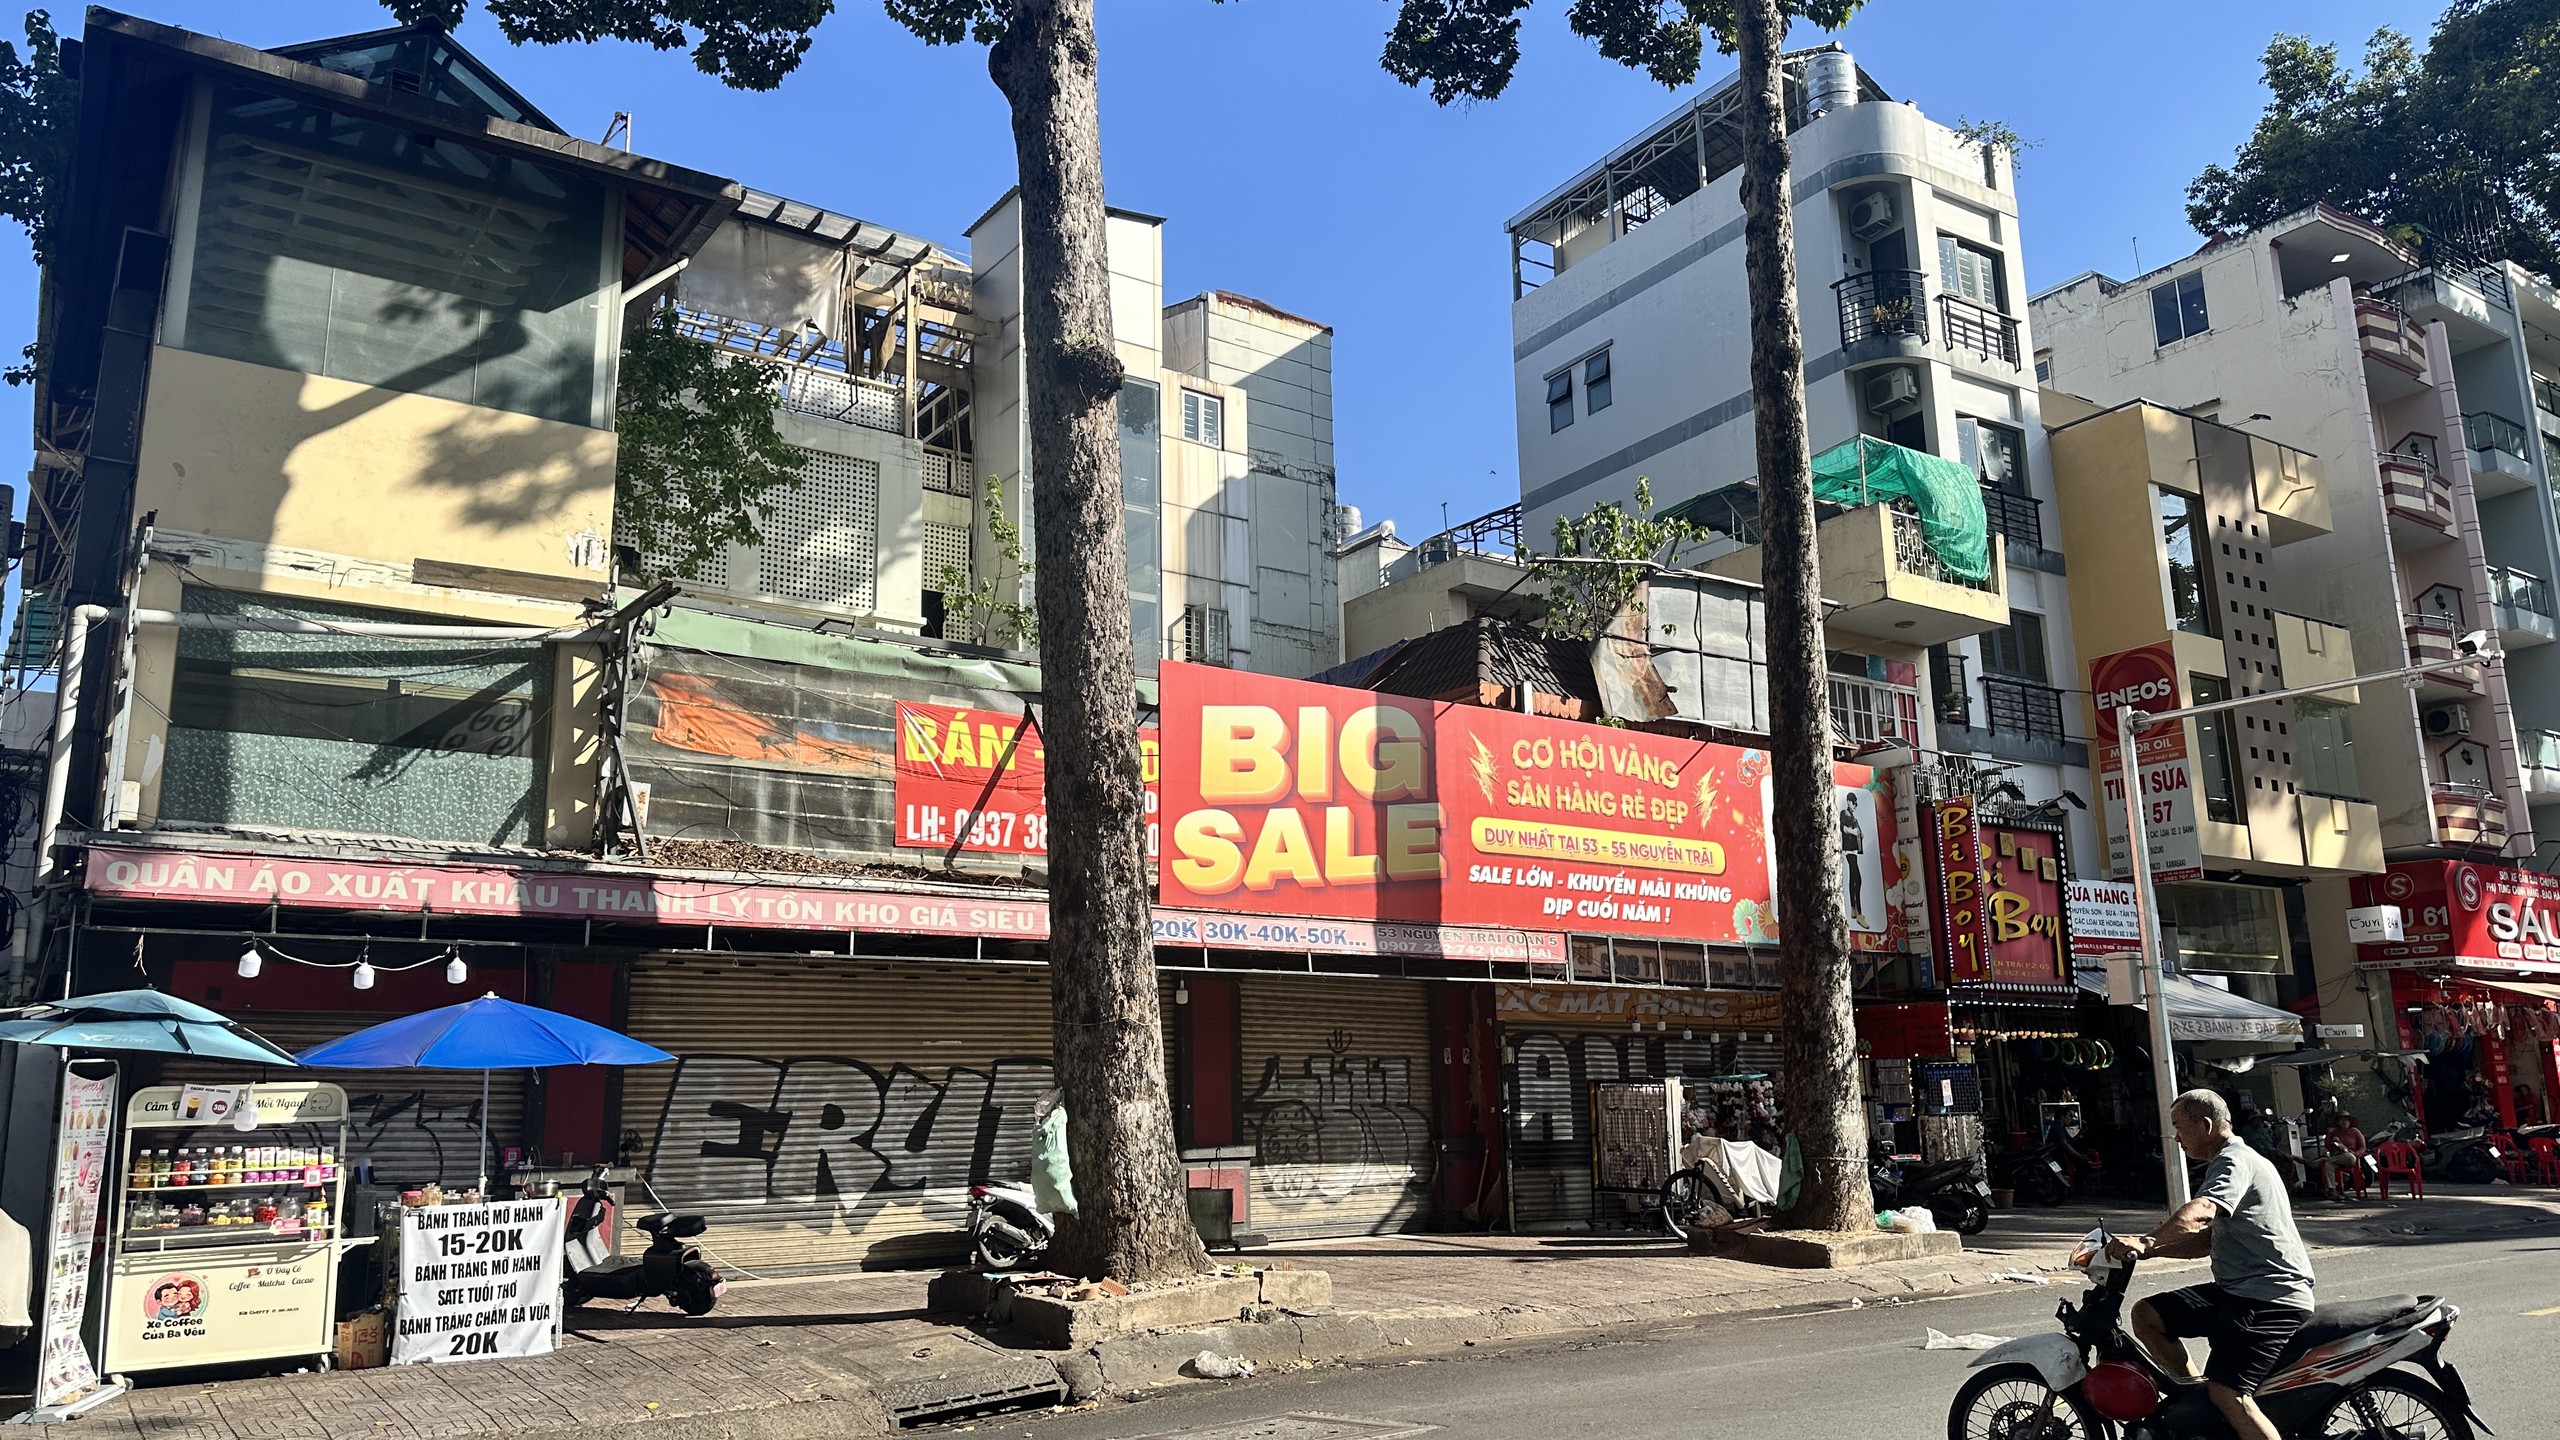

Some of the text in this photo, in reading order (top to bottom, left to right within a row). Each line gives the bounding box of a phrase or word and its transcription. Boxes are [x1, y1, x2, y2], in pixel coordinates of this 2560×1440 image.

[2097, 678, 2171, 710] ENEOS
[904, 712, 1016, 770] BÁN
[1200, 705, 1429, 805] BIG
[2110, 738, 2172, 759] MOR OIL
[1512, 734, 1681, 790] CƠ HỘI VÀNG
[2151, 764, 2188, 793] SỬA
[1556, 781, 1617, 818] HÀNG
[1621, 789, 1647, 820] RẺ
[1650, 799, 1689, 831] ĐẸP
[2153, 800, 2173, 824] 57
[906, 804, 946, 843] LH:
[954, 808, 1017, 847] 0937
[1171, 802, 1448, 895] SALE
[1484, 826, 1714, 865] DUY NHẤT TẠI 53 55 NGUYỄN TRÃI
[106, 857, 234, 891] QUẦN
[249, 863, 312, 895] ÁO
[325, 868, 436, 901] XUẤT
[451, 872, 560, 908] KHẨU
[572, 886, 694, 914] THANH
[711, 890, 752, 918] LÝ
[754, 891, 823, 921] TỒN
[835, 901, 900, 925] KHO
[909, 901, 960, 928] GIÁ
[968, 904, 1034, 931] SIÊU
[1469, 864, 1732, 904] SALE LỚN KHUYẾN MÃI KHỦNG
[2094, 886, 2130, 906] HÀNG
[1543, 894, 1661, 923] DỊP CUỐI NĂM
[2423, 905, 2449, 927] 61
[1152, 919, 1197, 939] 20K
[1377, 926, 1398, 939] 53
[1549, 936, 1558, 947] 5
[1988, 890, 2065, 977] Boy
[1378, 940, 1418, 952] 0907
[1424, 943, 1454, 954] 222
[1458, 944, 1485, 956] 742
[1557, 986, 1631, 1021] MẶT
[1637, 990, 1730, 1018] HÀNG
[2182, 1021, 2195, 1033] XE
[2197, 1021, 2203, 1033] 2
[2205, 1018, 2234, 1034] BÁNH
[2240, 1022, 2254, 1035] XE
[144, 1100, 169, 1112] Cảm
[418, 1204, 543, 1230] BÁNH TRÁNG MỠ HÀNH
[438, 1228, 523, 1257] 15-20K
[415, 1254, 541, 1282] BÁNH TRÁNG MỠ HÀNH
[257, 1279, 286, 1288] Matcha
[438, 1279, 518, 1306] SATE TUỔI THƠ
[142, 1327, 165, 1341] Của
[167, 1329, 181, 1339] Ba
[147, 1317, 204, 1330] Xe Coffee
[400, 1317, 432, 1336] BÁNH
[435, 1312, 472, 1333] TRÁNG
[475, 1305, 508, 1328] CHẤM
[511, 1304, 526, 1323] GÀ
[449, 1331, 499, 1356] 20K
